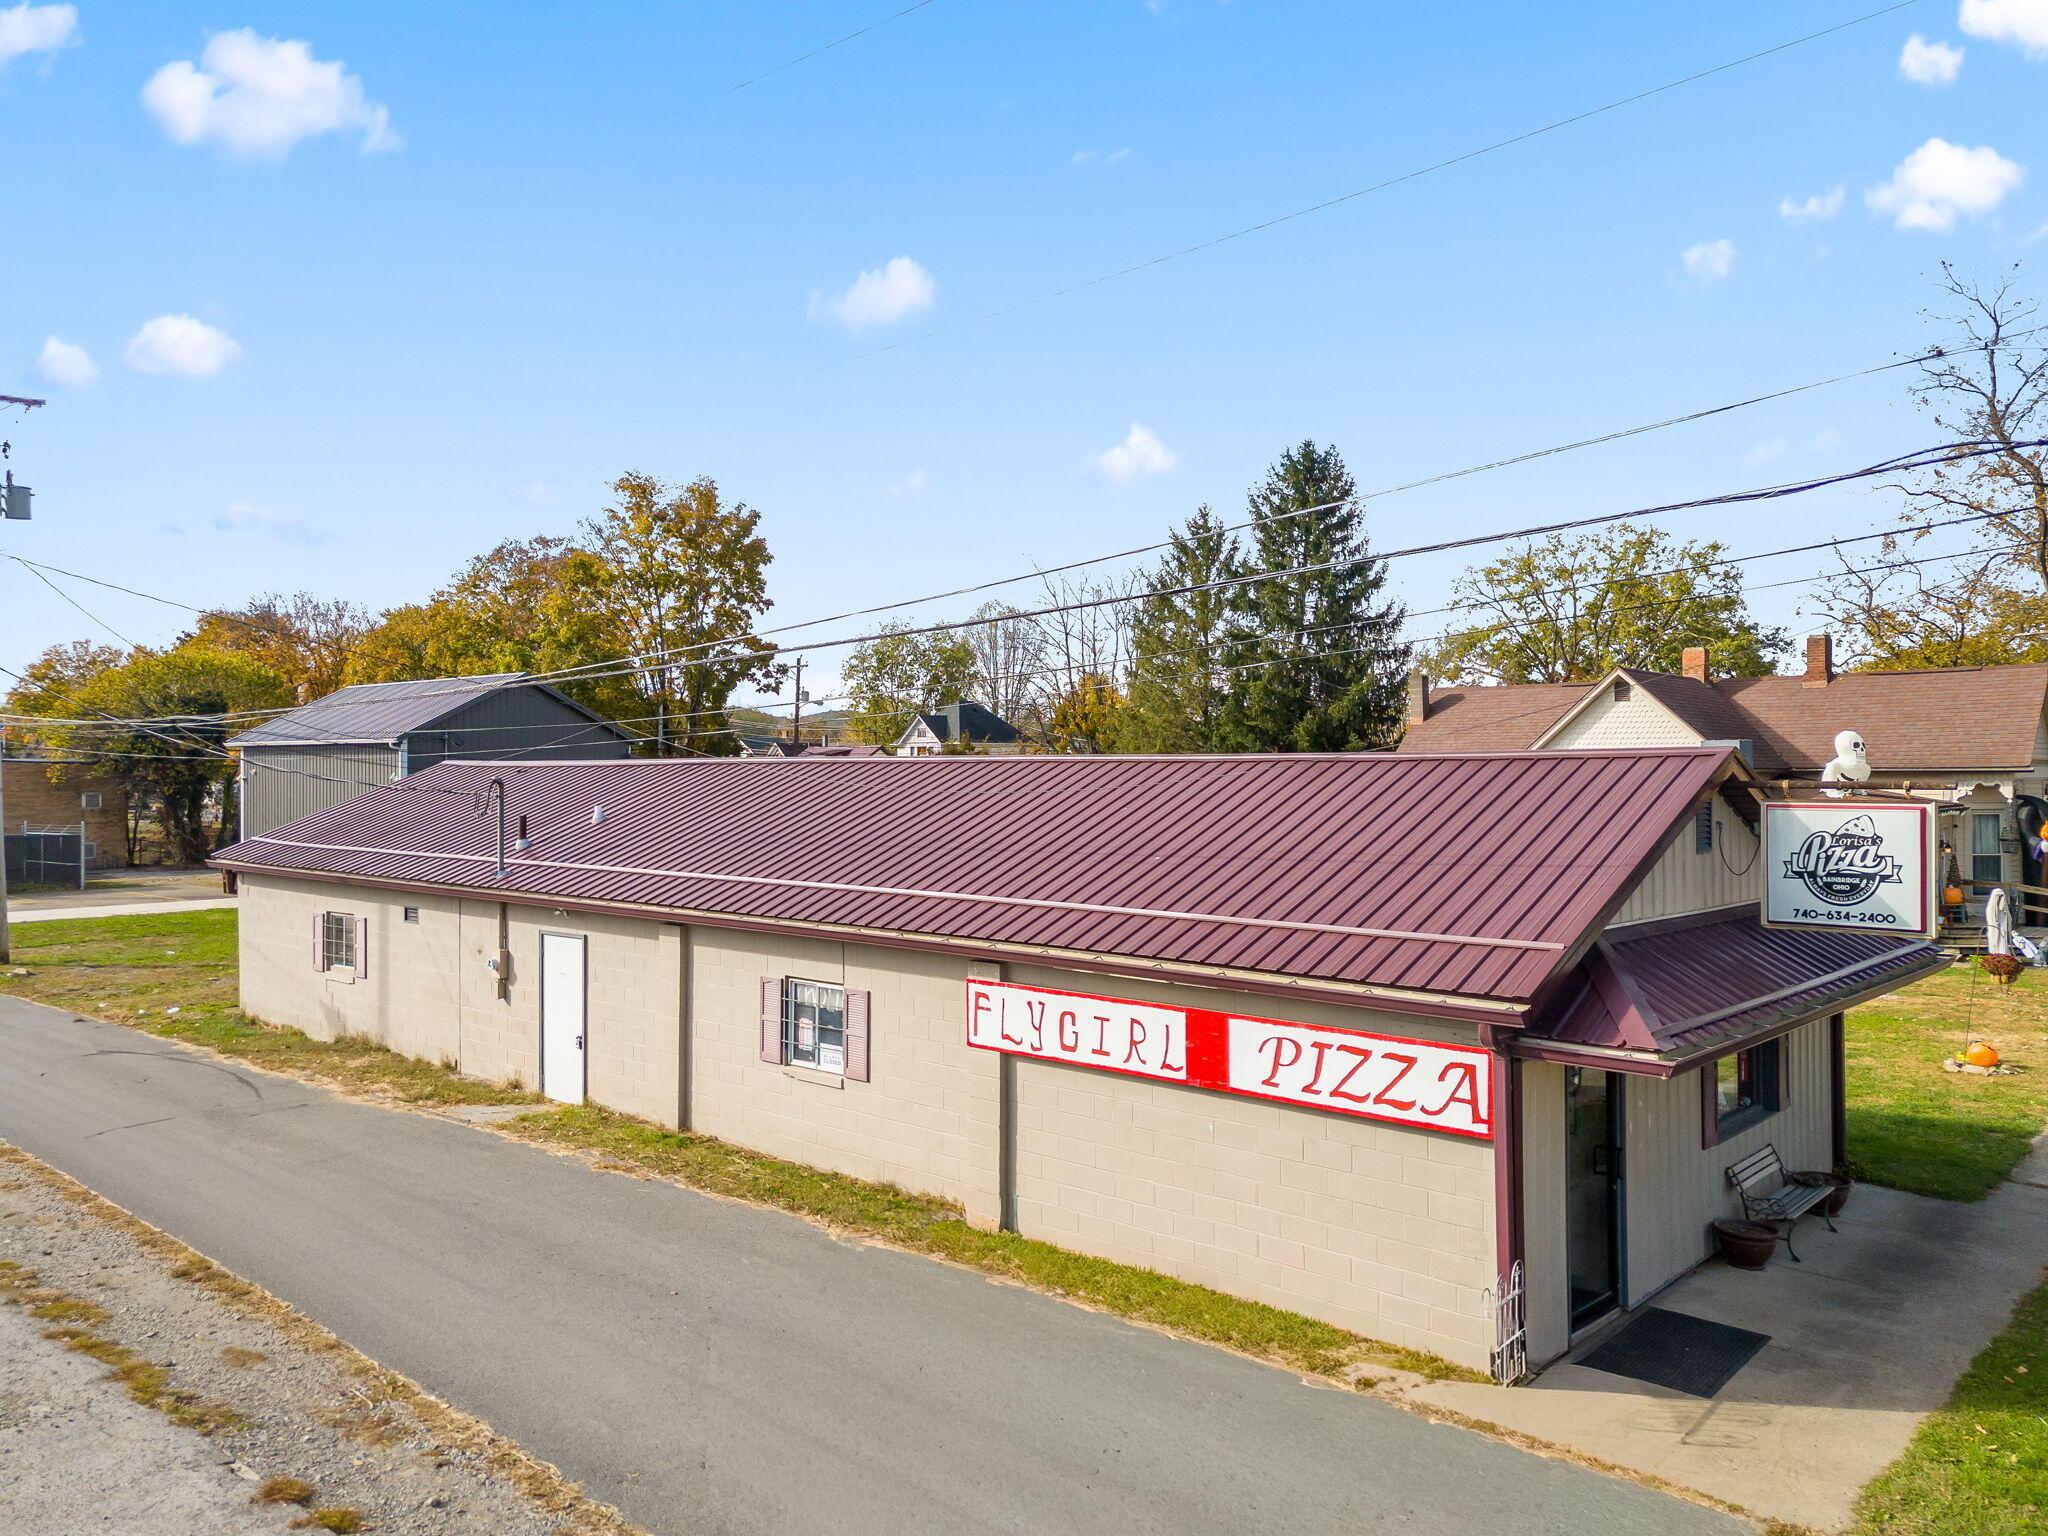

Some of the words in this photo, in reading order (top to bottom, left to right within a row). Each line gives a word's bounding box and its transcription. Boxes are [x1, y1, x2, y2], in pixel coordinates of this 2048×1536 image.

[1831, 834, 1882, 846] Lorisa's
[1798, 831, 1887, 877] Pizza
[1809, 878, 1827, 897] ALWAYS
[1827, 894, 1848, 902] FRESH
[1849, 880, 1875, 901] EVERYDAY
[1823, 876, 1861, 884] BAINBRIDGE
[1793, 908, 1897, 924] 740-634-2400
[973, 991, 1185, 1071] FLYGIRL
[1258, 1036, 1489, 1126] PIZZA
